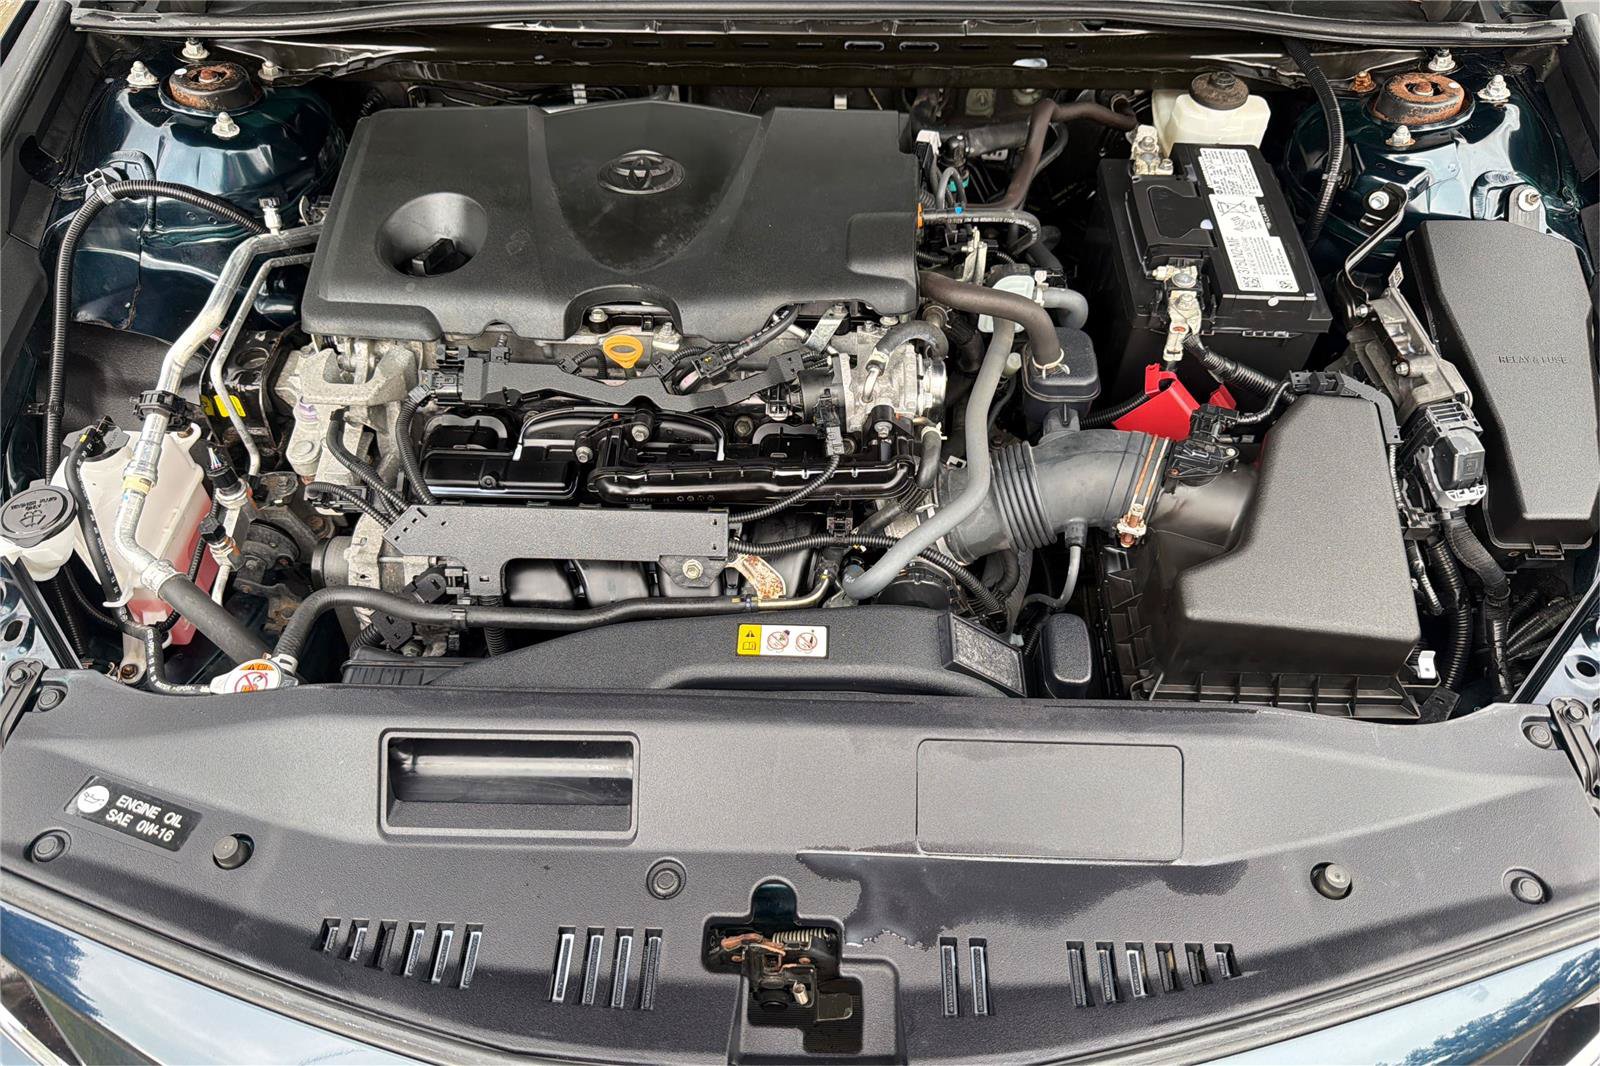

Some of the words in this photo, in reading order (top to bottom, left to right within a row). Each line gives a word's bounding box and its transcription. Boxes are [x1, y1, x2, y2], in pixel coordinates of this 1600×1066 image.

[1498, 355, 1530, 364] RELAY
[1541, 355, 1568, 364] FUSE
[105, 809, 134, 827] SAE
[135, 820, 175, 842] 0W-16
[116, 794, 162, 819] ENGINE
[163, 812, 184, 828] OIL
